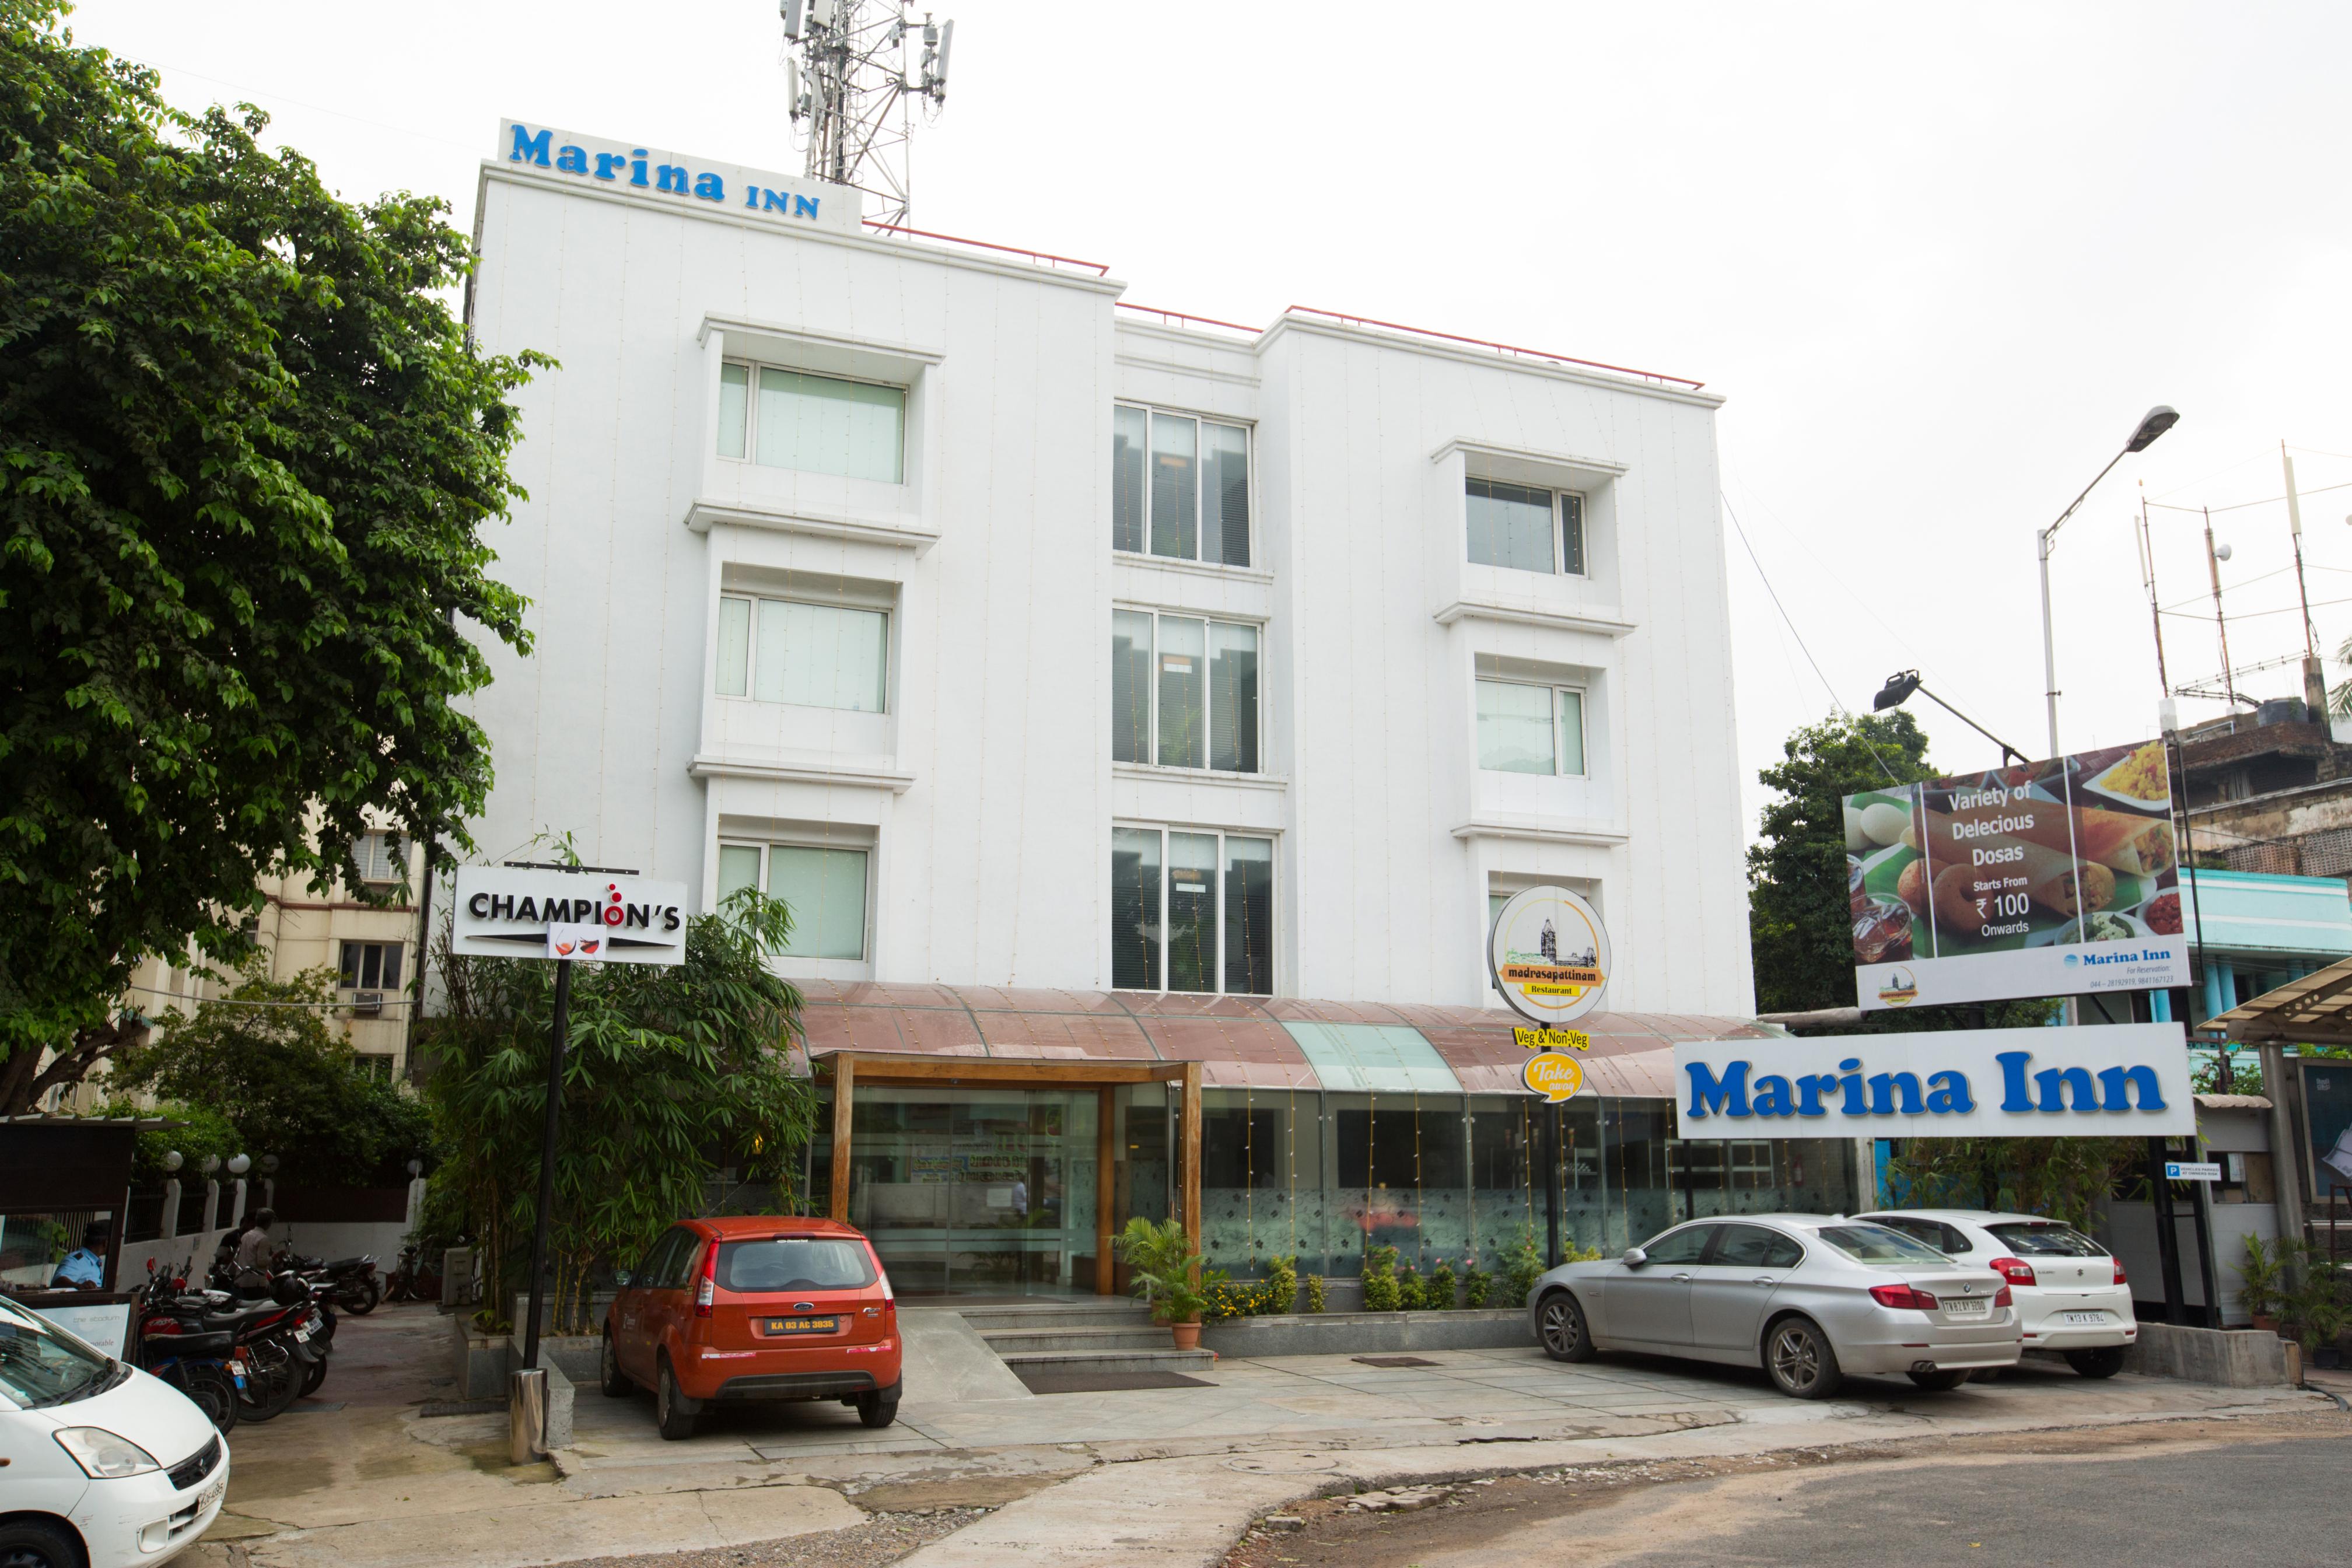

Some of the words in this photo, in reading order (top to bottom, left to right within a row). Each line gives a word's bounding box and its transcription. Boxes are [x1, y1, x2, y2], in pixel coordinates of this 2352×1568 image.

[509, 124, 725, 202] Marina
[746, 186, 820, 220] INN
[1948, 788, 2008, 811] Variety
[2014, 780, 2031, 800] of
[1952, 814, 2034, 840] Delecious
[1972, 846, 2024, 866] Dosas
[1973, 879, 2001, 891] Starts
[2003, 877, 2028, 887] From
[468, 891, 680, 930] CHAMPION'S
[1994, 892, 2029, 916] 100
[1982, 920, 2029, 936] Onwards
[2083, 952, 2138, 965] Marina
[2142, 950, 2171, 960] Inn
[1508, 967, 1596, 982] madrasapattinam
[2137, 965, 2171, 974] Reservation:
[1531, 985, 1572, 995] Restaurant
[1517, 1030, 1535, 1046] Veg
[1538, 1030, 1545, 1043] &
[1549, 1031, 1587, 1048] Non-Veg
[1533, 1060, 1575, 1082] Take
[1549, 1082, 1574, 1094] away
[1685, 1058, 1977, 1118] Marina
[1995, 1051, 2169, 1112] Inn
[771, 1322, 783, 1330] KA
[786, 1321, 797, 1329] 03
[799, 1321, 810, 1329] AC
